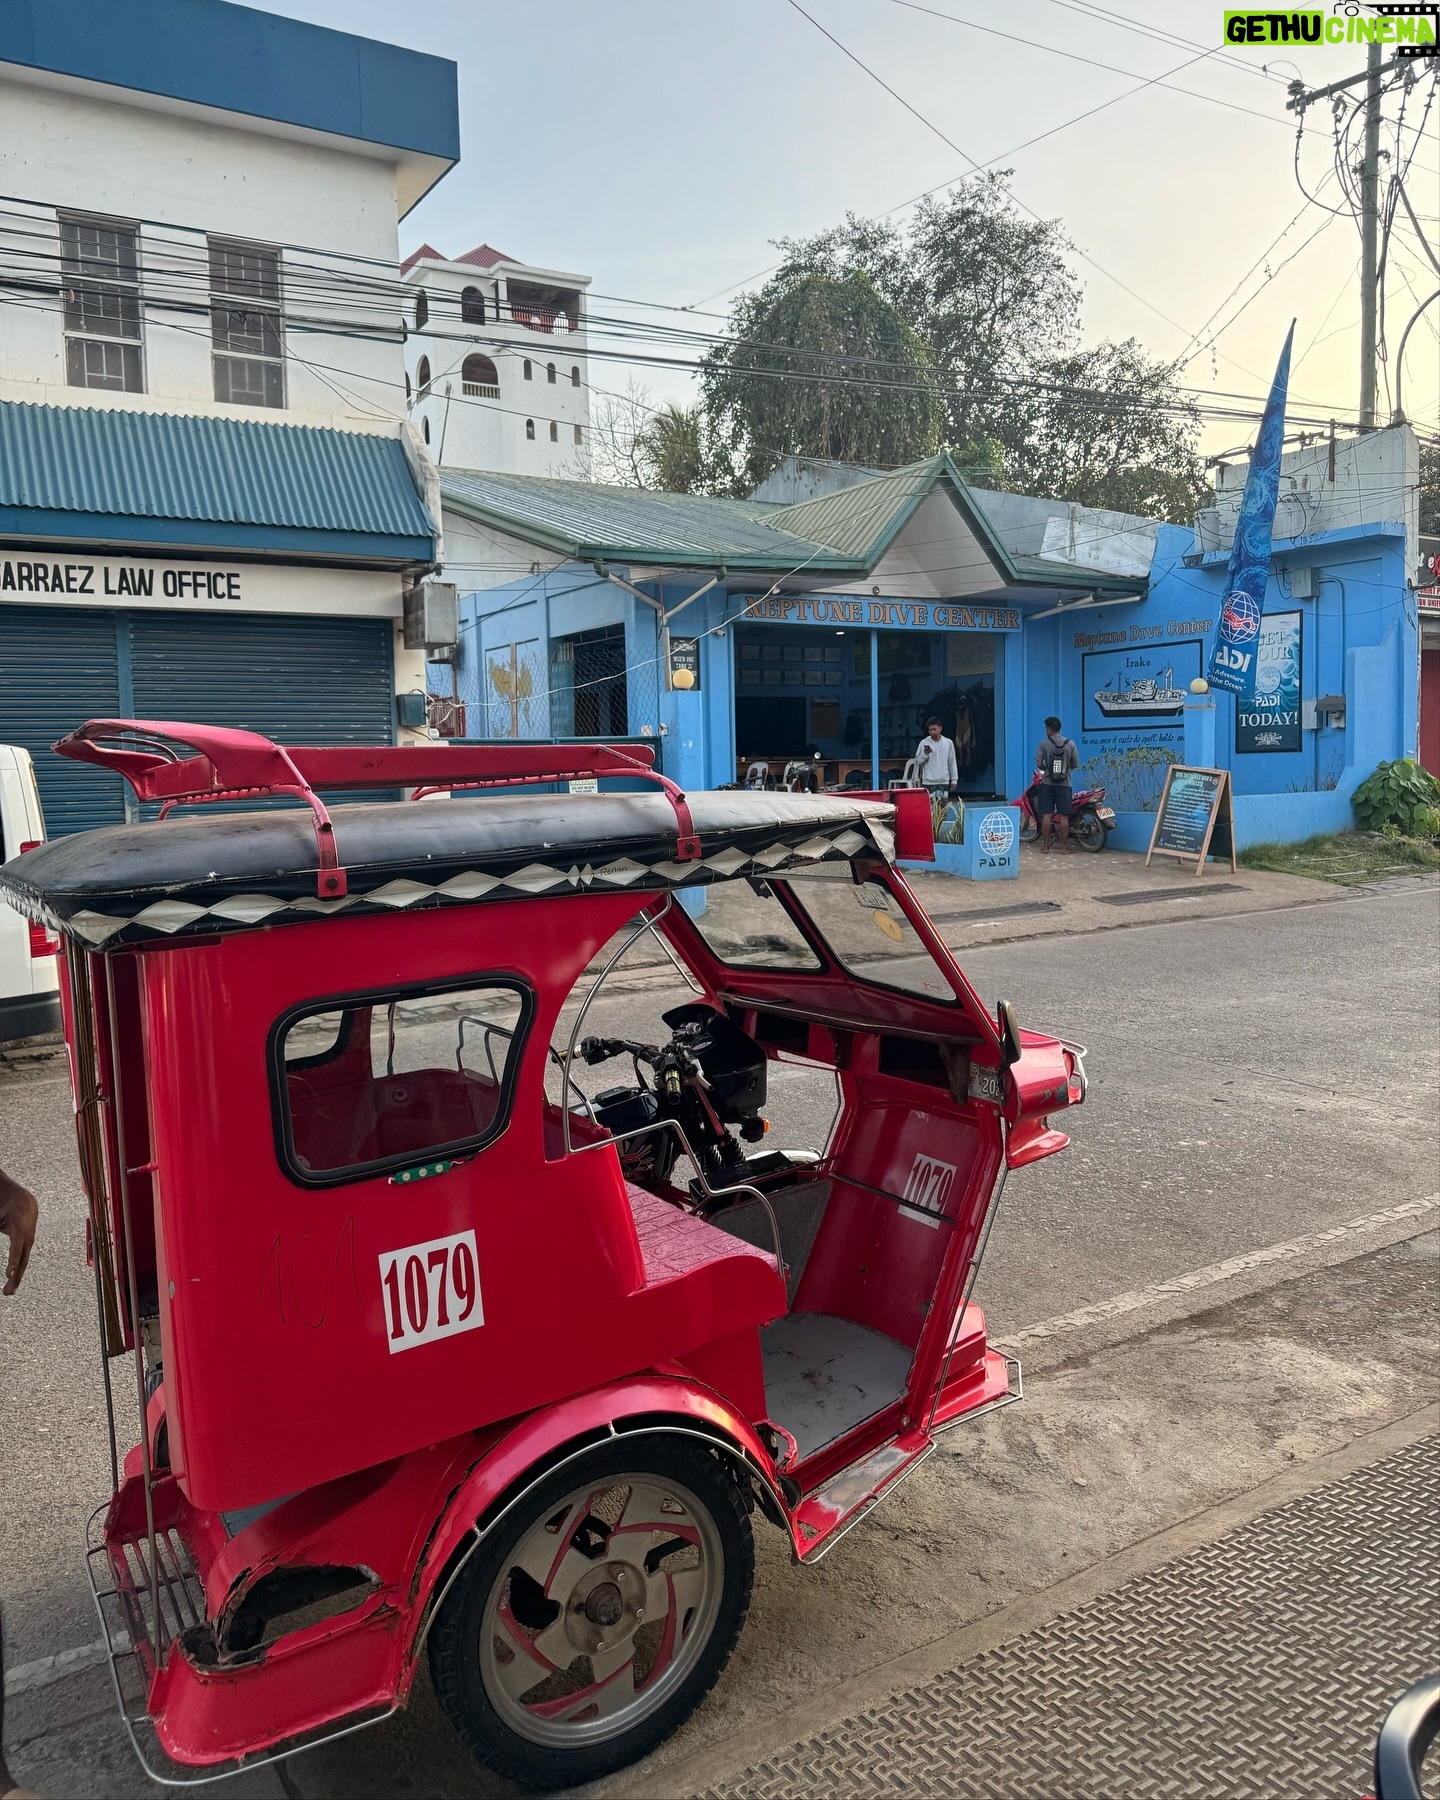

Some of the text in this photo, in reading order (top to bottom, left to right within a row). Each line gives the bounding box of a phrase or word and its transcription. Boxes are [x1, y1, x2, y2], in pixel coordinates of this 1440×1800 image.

[0, 561, 241, 600] ARRAEZ LAW OFFICE
[745, 596, 1020, 629] NEPTUNE DIVE CENTER
[1074, 618, 1212, 651] Neptune Dive Center
[1125, 656, 1151, 668] Irako
[1215, 645, 1251, 673] ADI
[1258, 646, 1294, 662] OUR
[1255, 695, 1280, 707] PADI
[1238, 711, 1298, 727] TODAY!
[979, 857, 1010, 868] PADI
[904, 1158, 953, 1213] 1079
[384, 1242, 476, 1340] 1079
